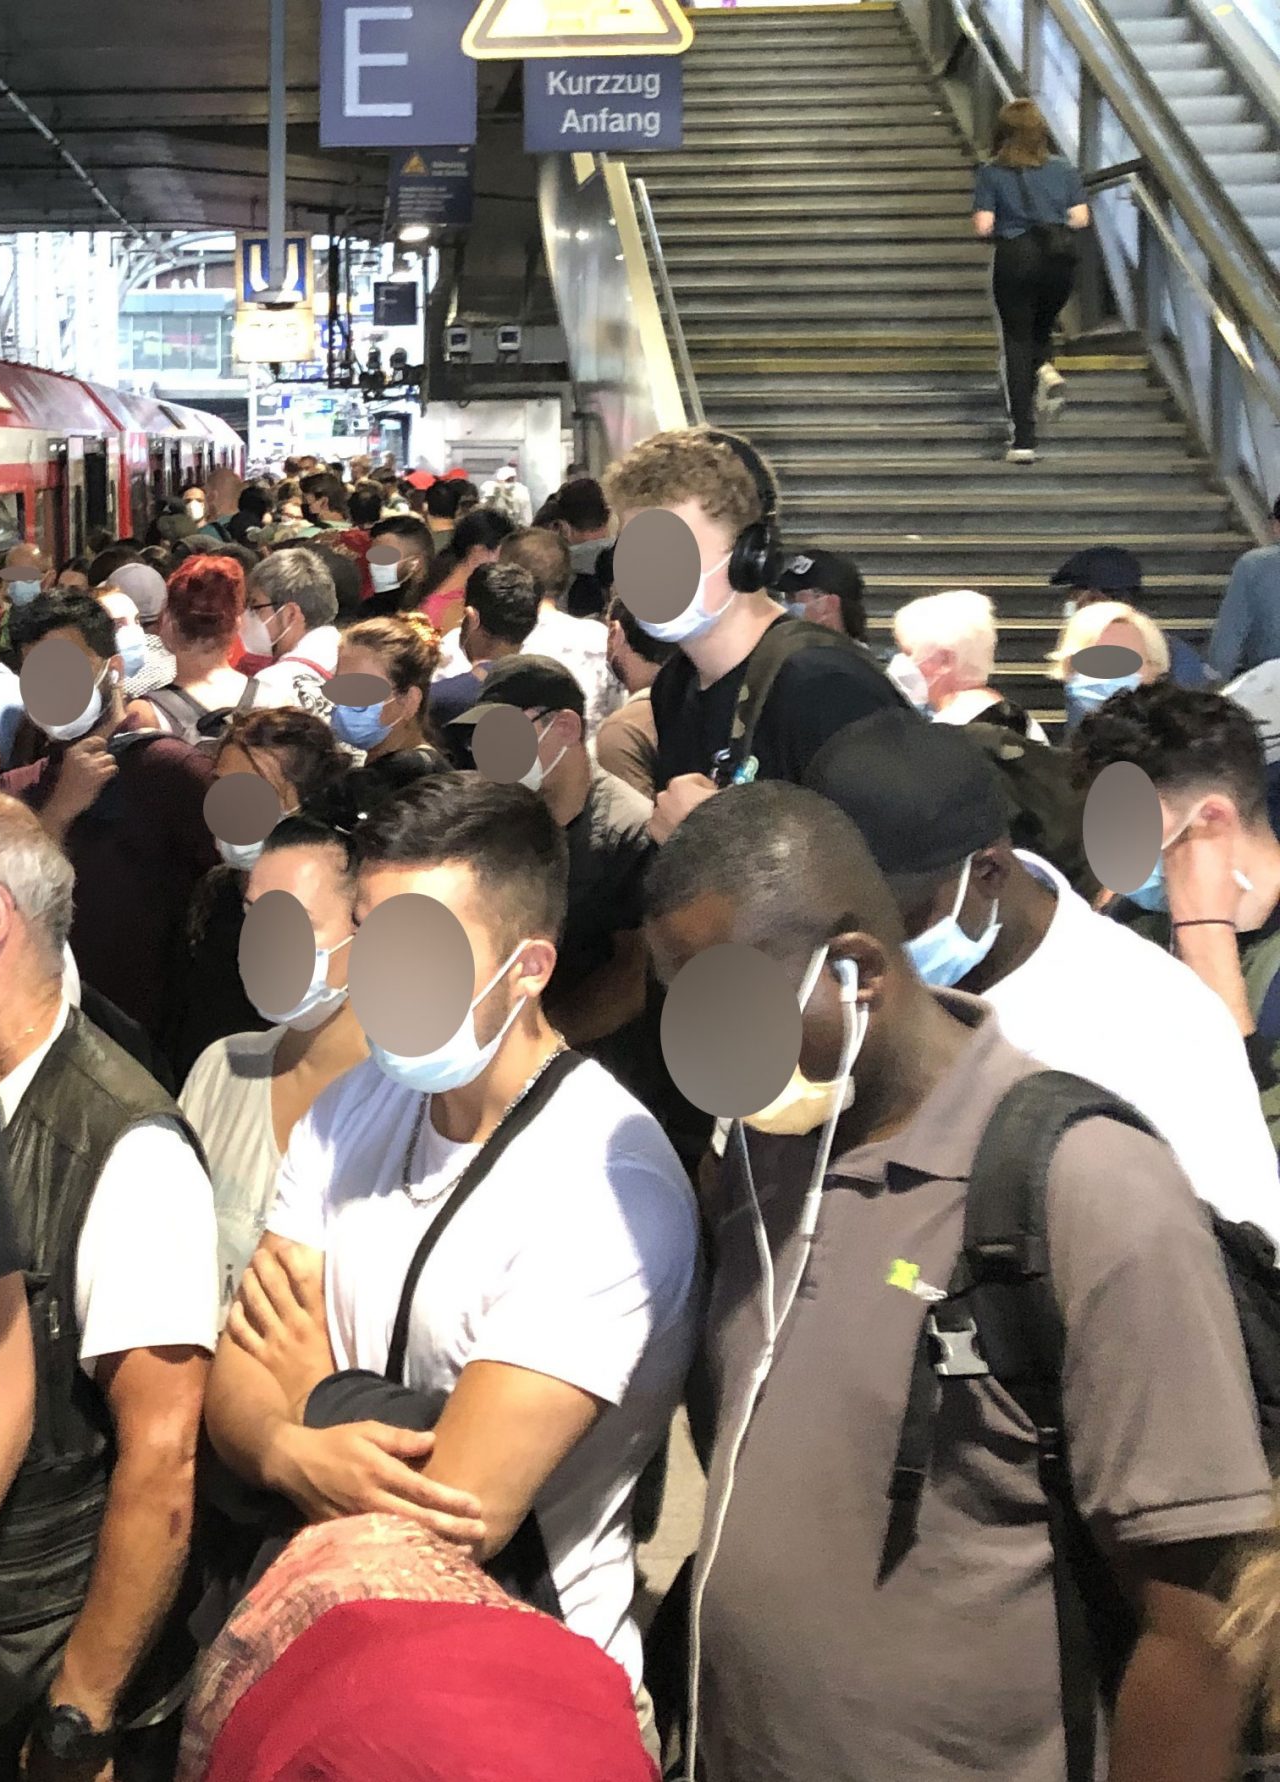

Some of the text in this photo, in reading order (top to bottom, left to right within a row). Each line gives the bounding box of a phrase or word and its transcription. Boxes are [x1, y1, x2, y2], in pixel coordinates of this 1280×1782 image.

[344, 6, 413, 117] E
[548, 71, 660, 99] Kurzzug
[560, 107, 660, 137] Anfang
